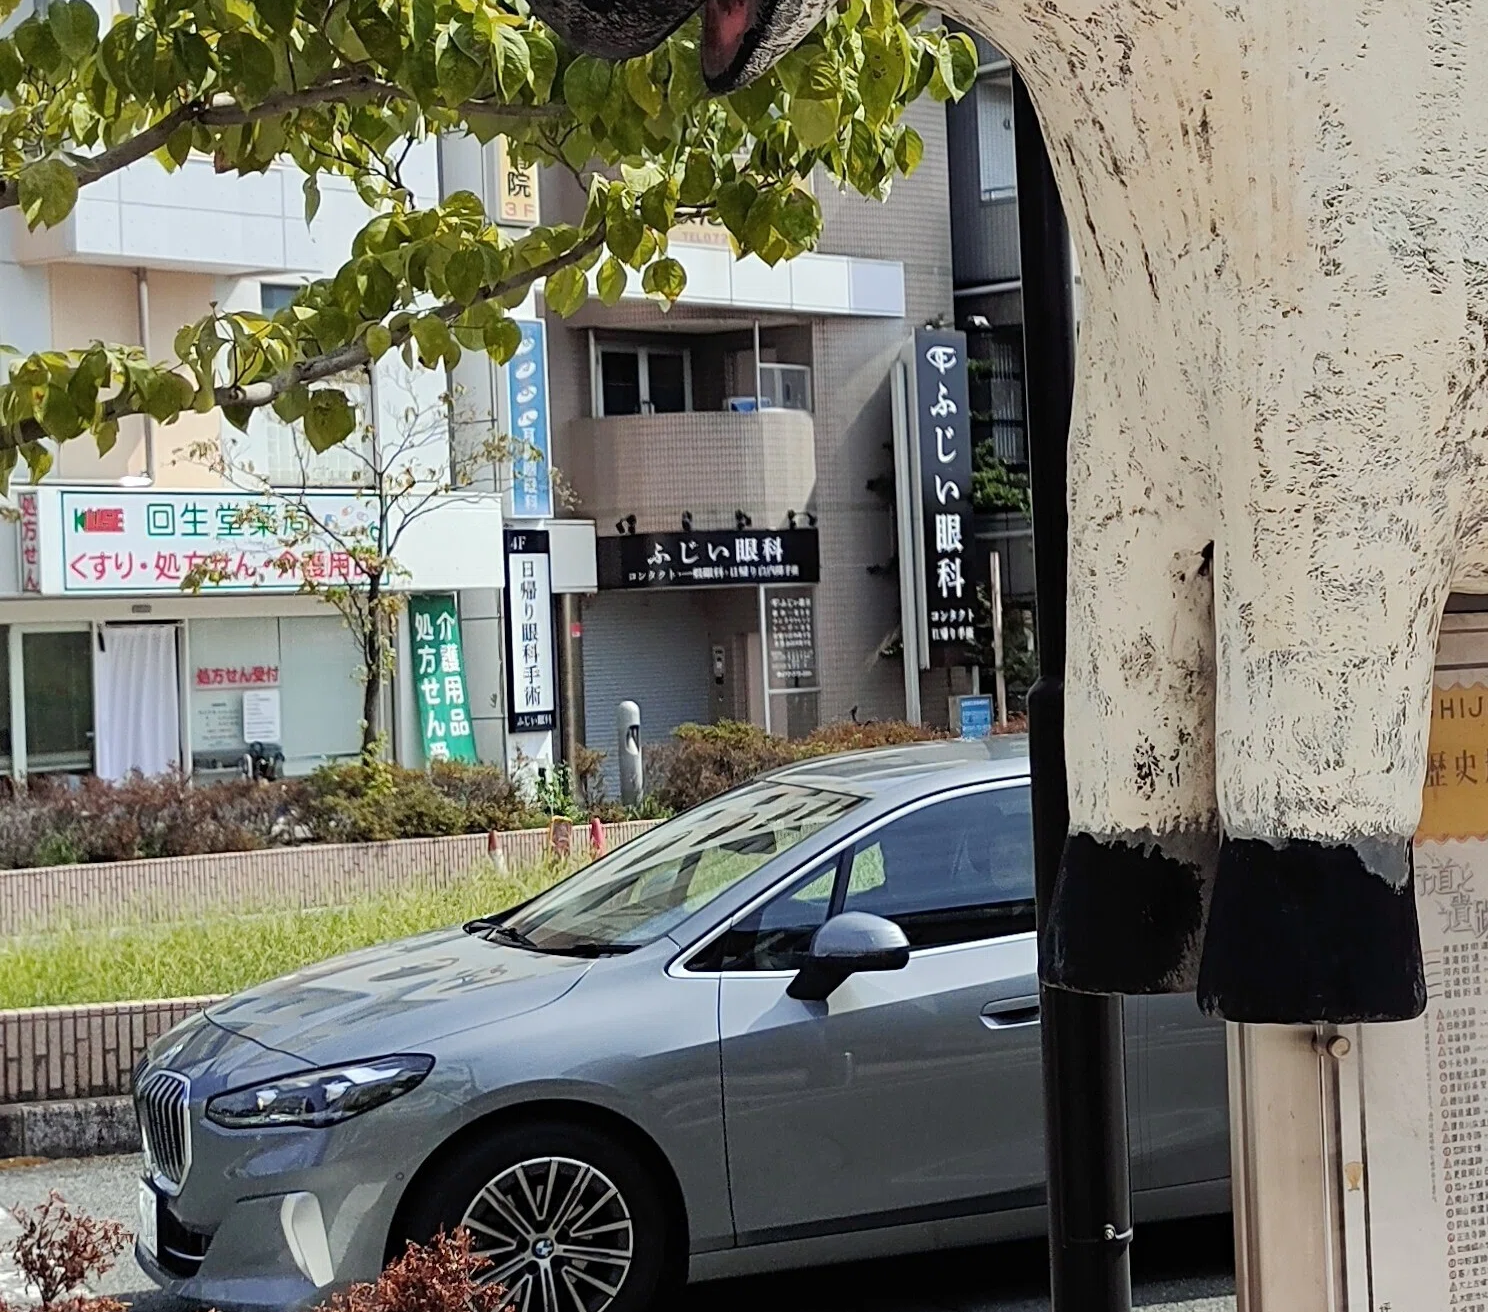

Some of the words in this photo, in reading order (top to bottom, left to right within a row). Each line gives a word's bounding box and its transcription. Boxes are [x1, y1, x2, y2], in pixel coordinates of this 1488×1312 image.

[647, 537, 783, 564] ふじい眼科
[929, 381, 965, 599] ふじい眼科
[436, 611, 470, 737] 介護用品
[520, 560, 542, 707] 日帰り眼科手術
